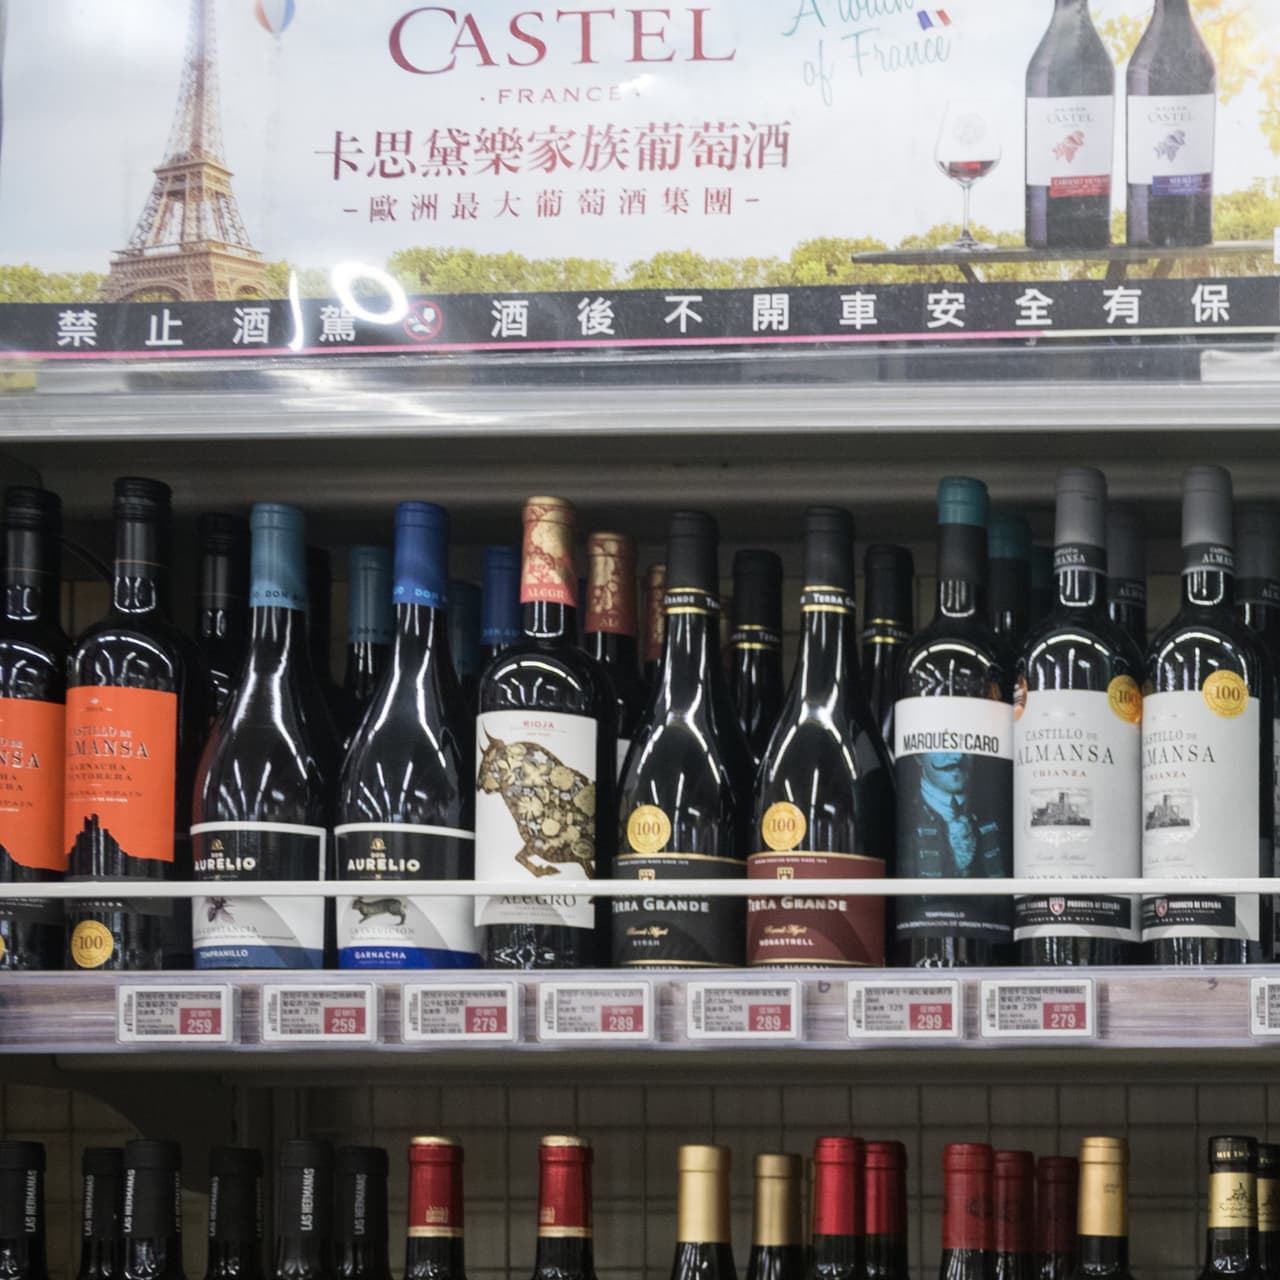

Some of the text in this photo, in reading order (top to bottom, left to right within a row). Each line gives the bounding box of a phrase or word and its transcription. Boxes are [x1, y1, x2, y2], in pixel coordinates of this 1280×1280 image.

[389, 6, 736, 75] CASTEL
[841, 27, 951, 76] France
[498, 86, 621, 104] FRANCE
[314, 120, 792, 181] 卡思黛樂家族葡萄酒
[903, 727, 999, 754] MARQUÉS CARO
[1025, 729, 1082, 744] CASTILLO
[1016, 743, 1115, 767] ALMANSA
[347, 858, 420, 873] AURELIO
[642, 897, 709, 913] GRANDE
[79, 935, 103, 950] 100
[188, 1019, 212, 1033] 259
[609, 1016, 634, 1031] 289
[1051, 1014, 1076, 1028] 279
